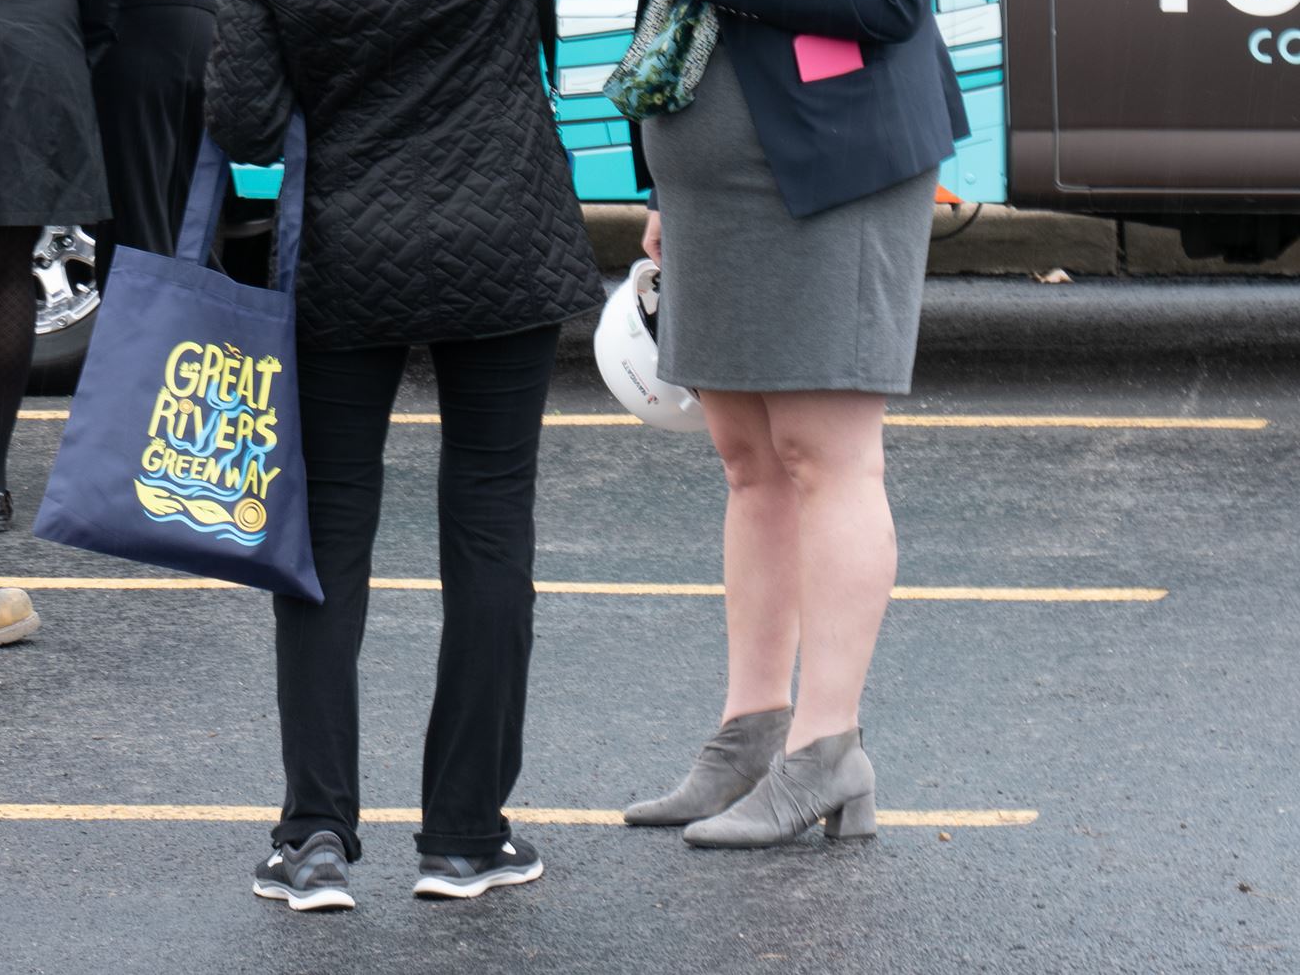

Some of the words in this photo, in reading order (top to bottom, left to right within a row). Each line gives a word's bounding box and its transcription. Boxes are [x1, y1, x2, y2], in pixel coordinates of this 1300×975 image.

[1247, 28, 1300, 64] CO
[165, 341, 282, 411] GREAT
[141, 437, 282, 499] GREENWAY
